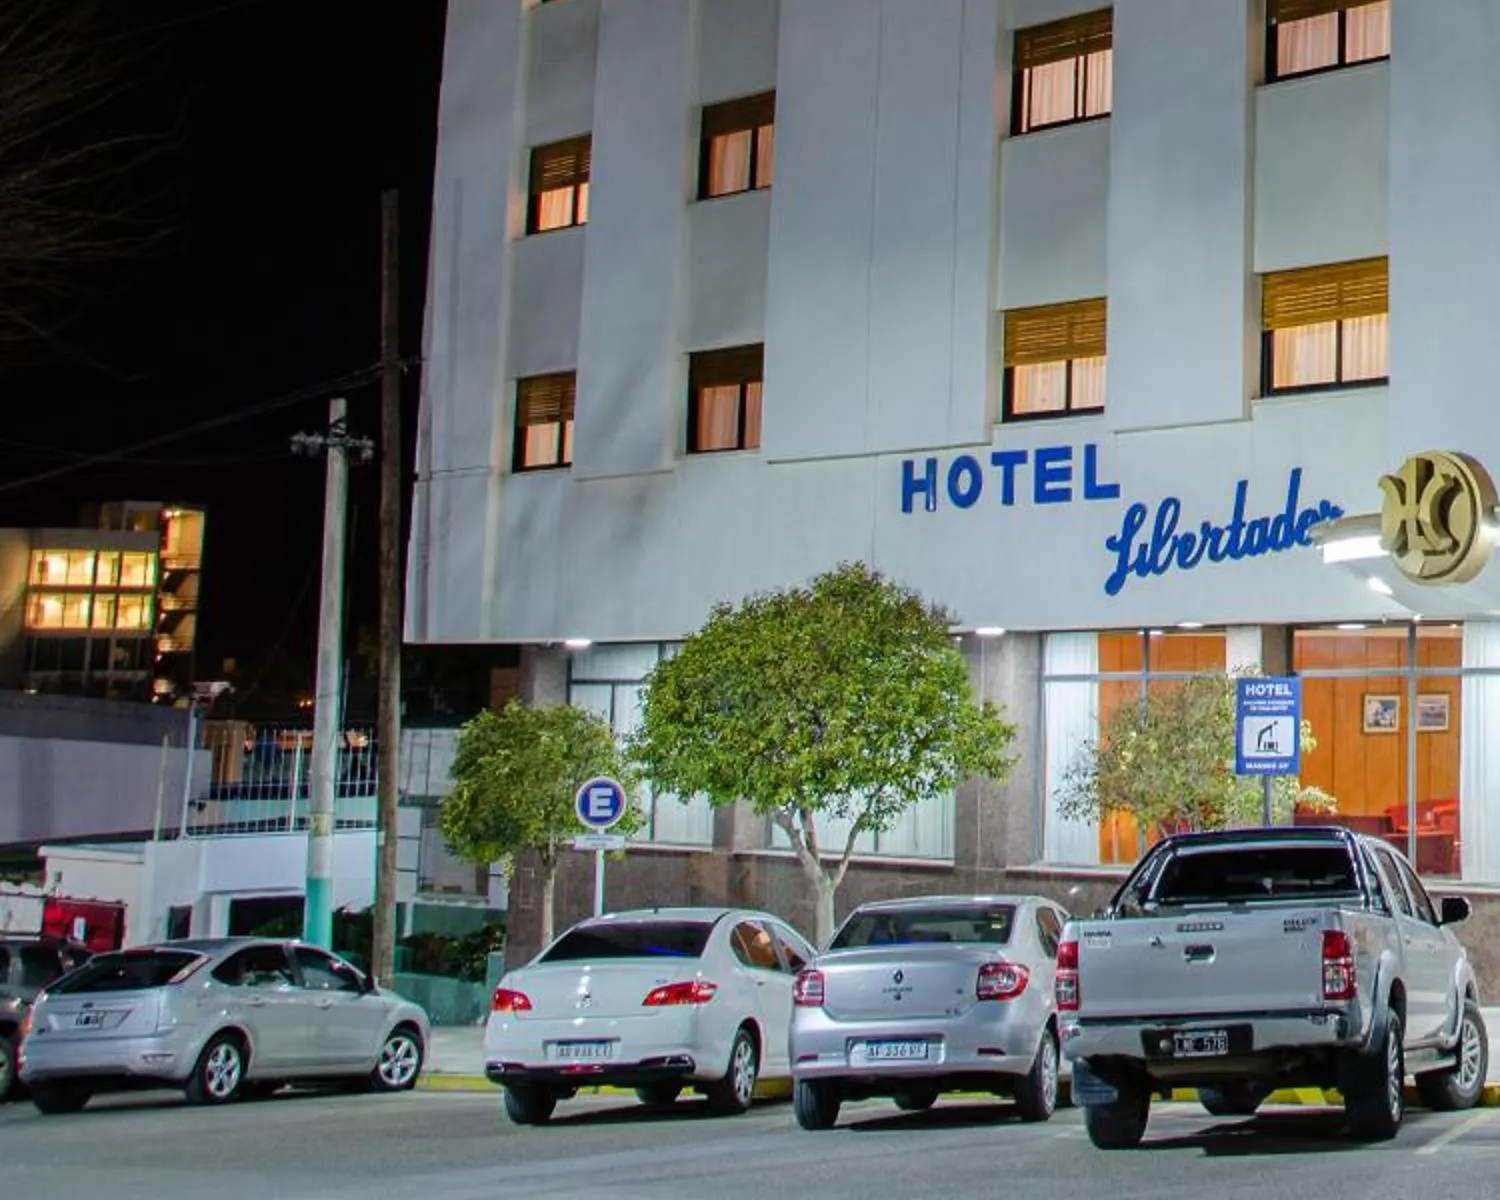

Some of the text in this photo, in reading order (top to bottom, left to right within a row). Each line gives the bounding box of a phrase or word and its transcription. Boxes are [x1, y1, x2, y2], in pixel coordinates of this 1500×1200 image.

[900, 443, 1121, 513] HOTEL
[1245, 683, 1293, 697] HOTEL
[589, 787, 613, 817] E
